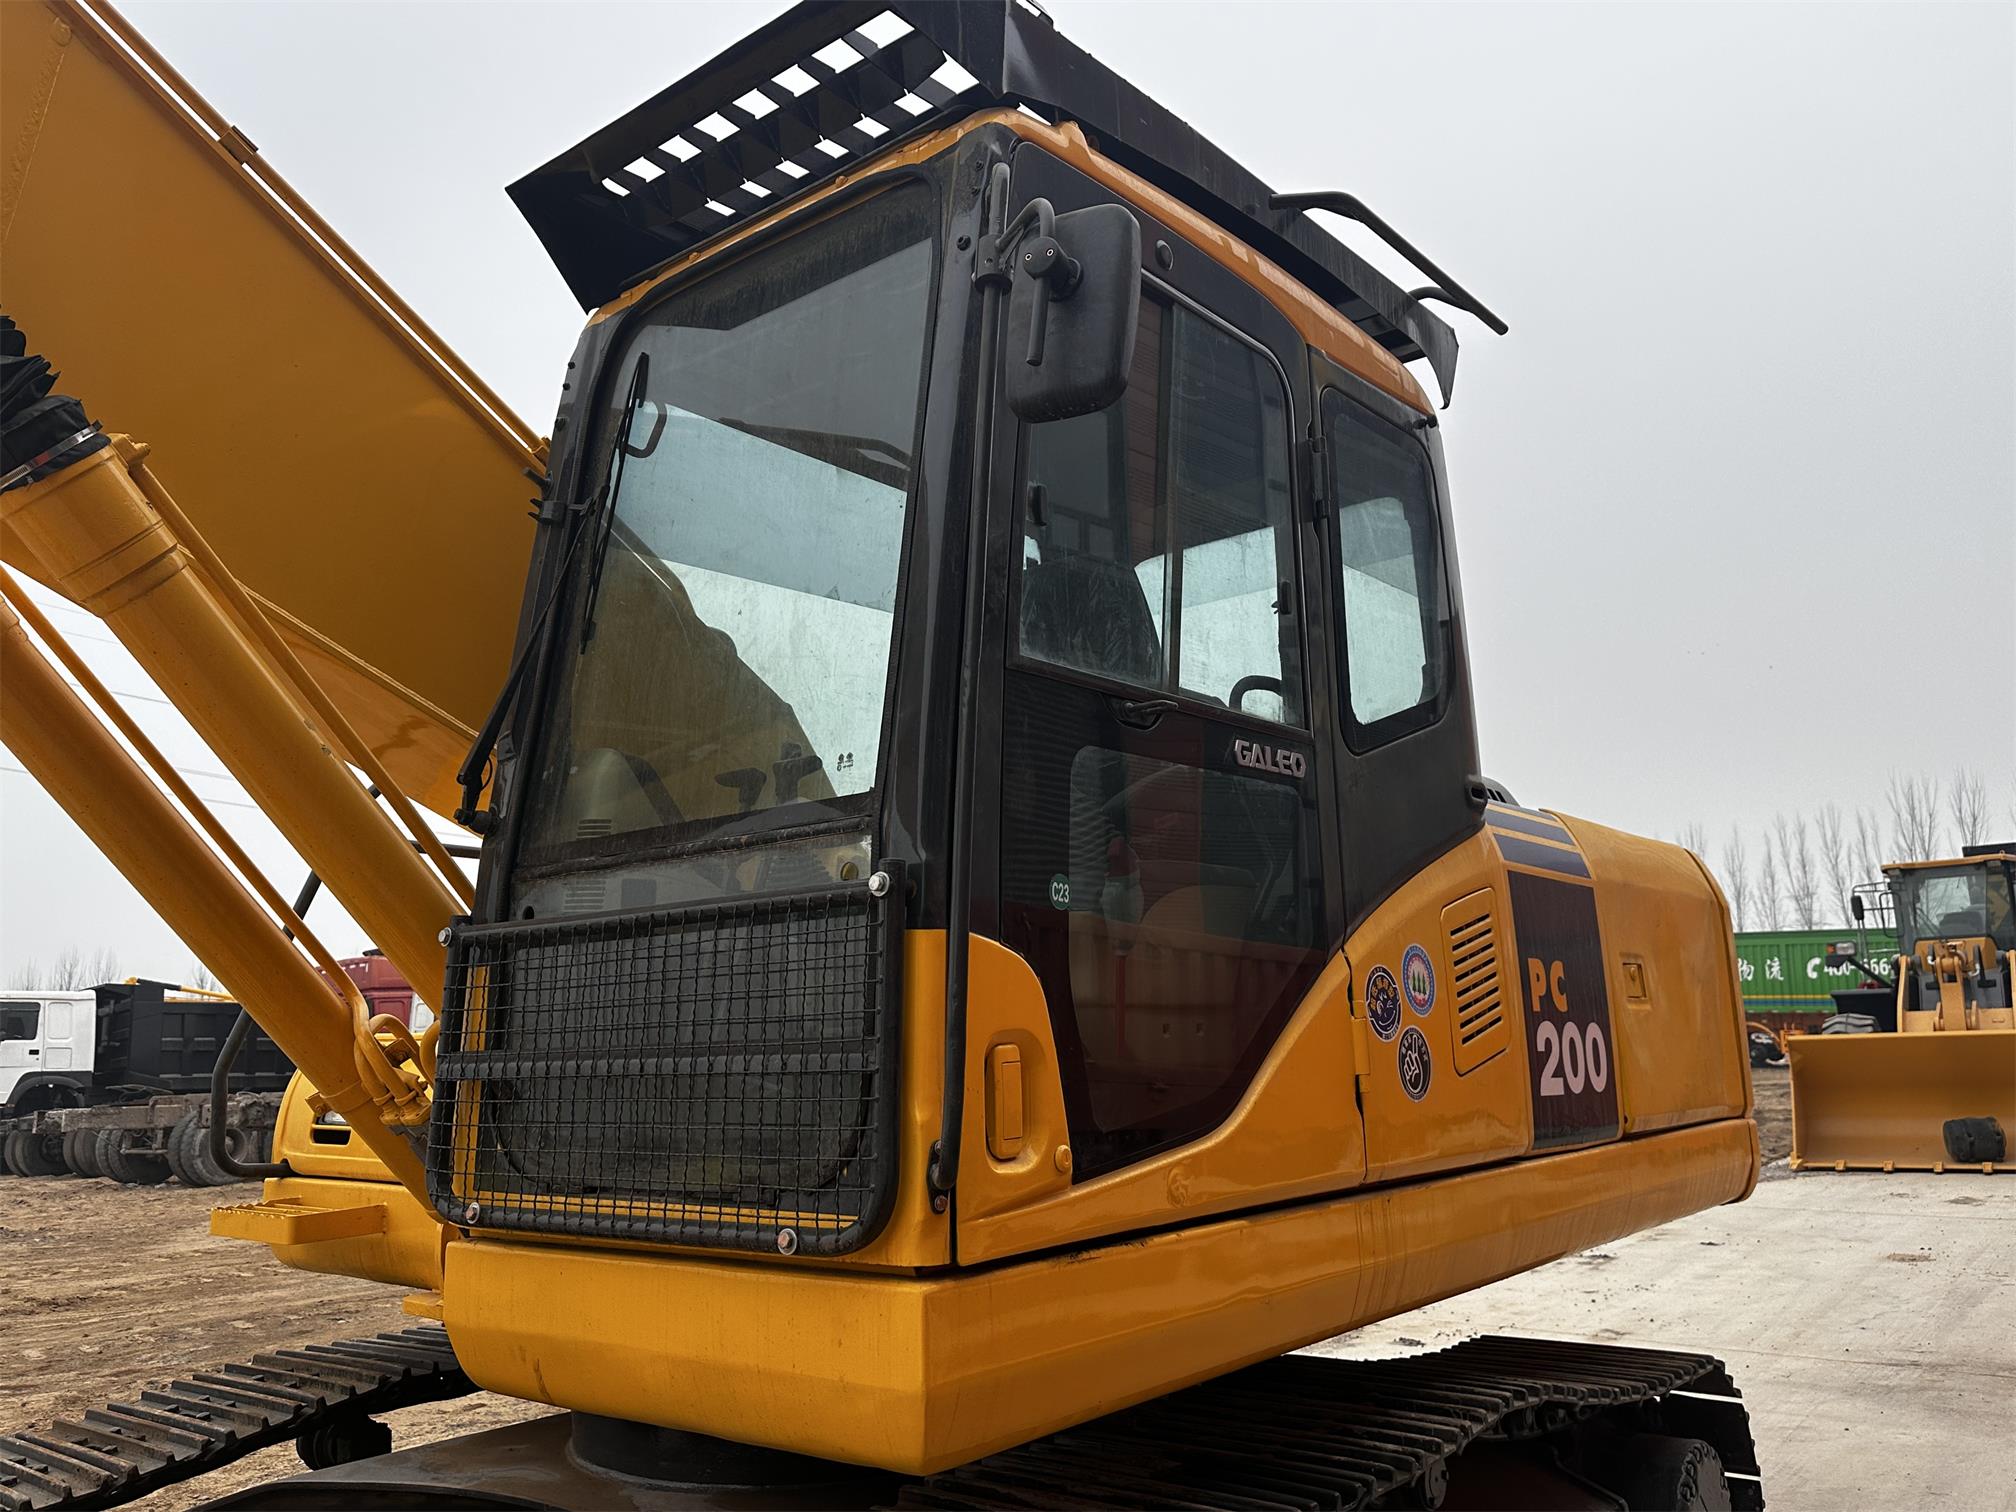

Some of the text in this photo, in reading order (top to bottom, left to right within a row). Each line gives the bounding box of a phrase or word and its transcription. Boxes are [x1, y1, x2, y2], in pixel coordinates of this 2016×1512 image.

[1234, 739, 1307, 778] GALEO
[1051, 881, 1070, 904] C23
[1527, 957, 1569, 1013] PC
[1536, 1020, 1608, 1097] 200
